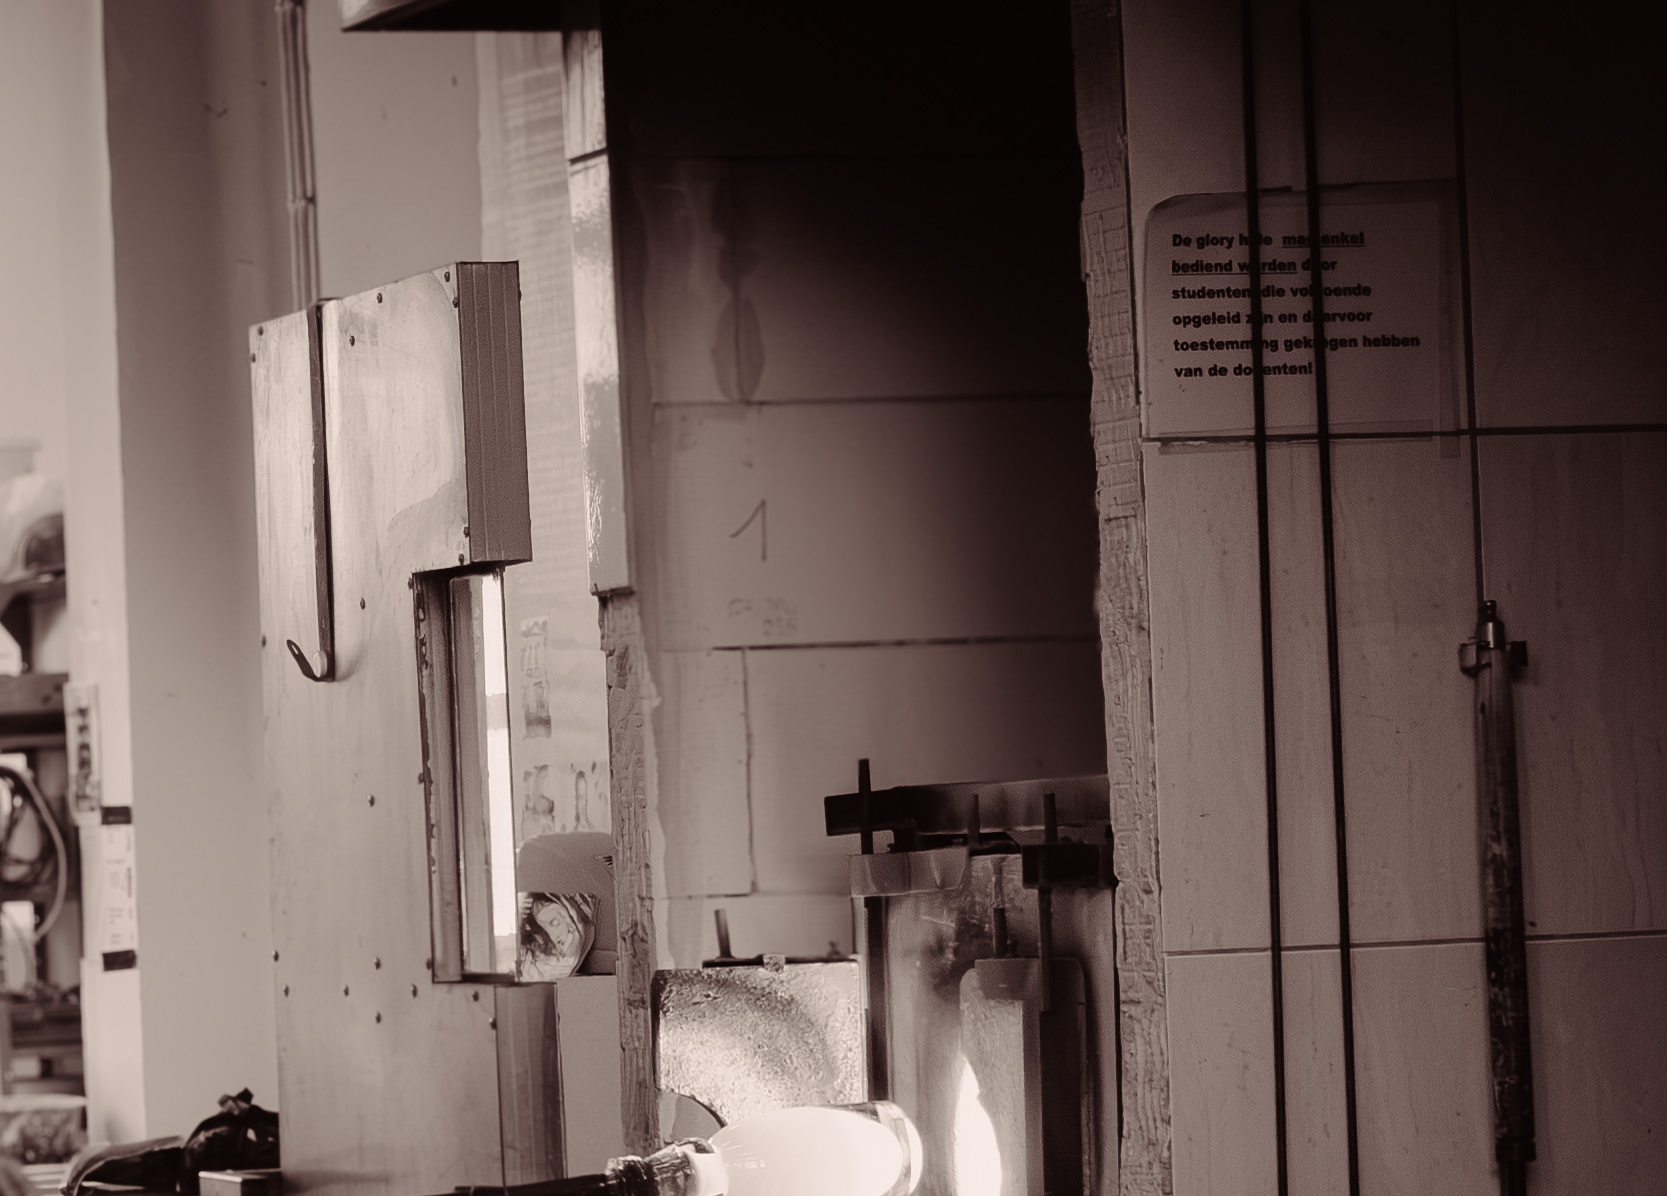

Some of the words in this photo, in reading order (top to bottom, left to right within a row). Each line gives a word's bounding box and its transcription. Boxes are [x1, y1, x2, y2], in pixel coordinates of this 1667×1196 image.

[1172, 234, 1192, 246] De
[1196, 234, 1234, 248] glory
[1239, 234, 1272, 246] hle
[1282, 236, 1314, 245] ma
[1322, 232, 1365, 244] enkel
[1172, 260, 1232, 273] bediend
[1238, 259, 1296, 271] wrden
[1301, 259, 1337, 270] dor
[1172, 287, 1251, 299] studenten
[1261, 285, 1285, 297] die
[1290, 284, 1371, 297] voloende
[1173, 312, 1241, 328] opgeleid
[1246, 313, 1273, 325] zn
[1278, 314, 1297, 323] en
[1303, 311, 1372, 322] darvoor
[1174, 339, 1278, 352] toestemmng
[1363, 335, 1420, 347] hebben
[1174, 367, 1202, 377] van
[1208, 364, 1228, 376] de
[1233, 362, 1312, 375] doenten!
